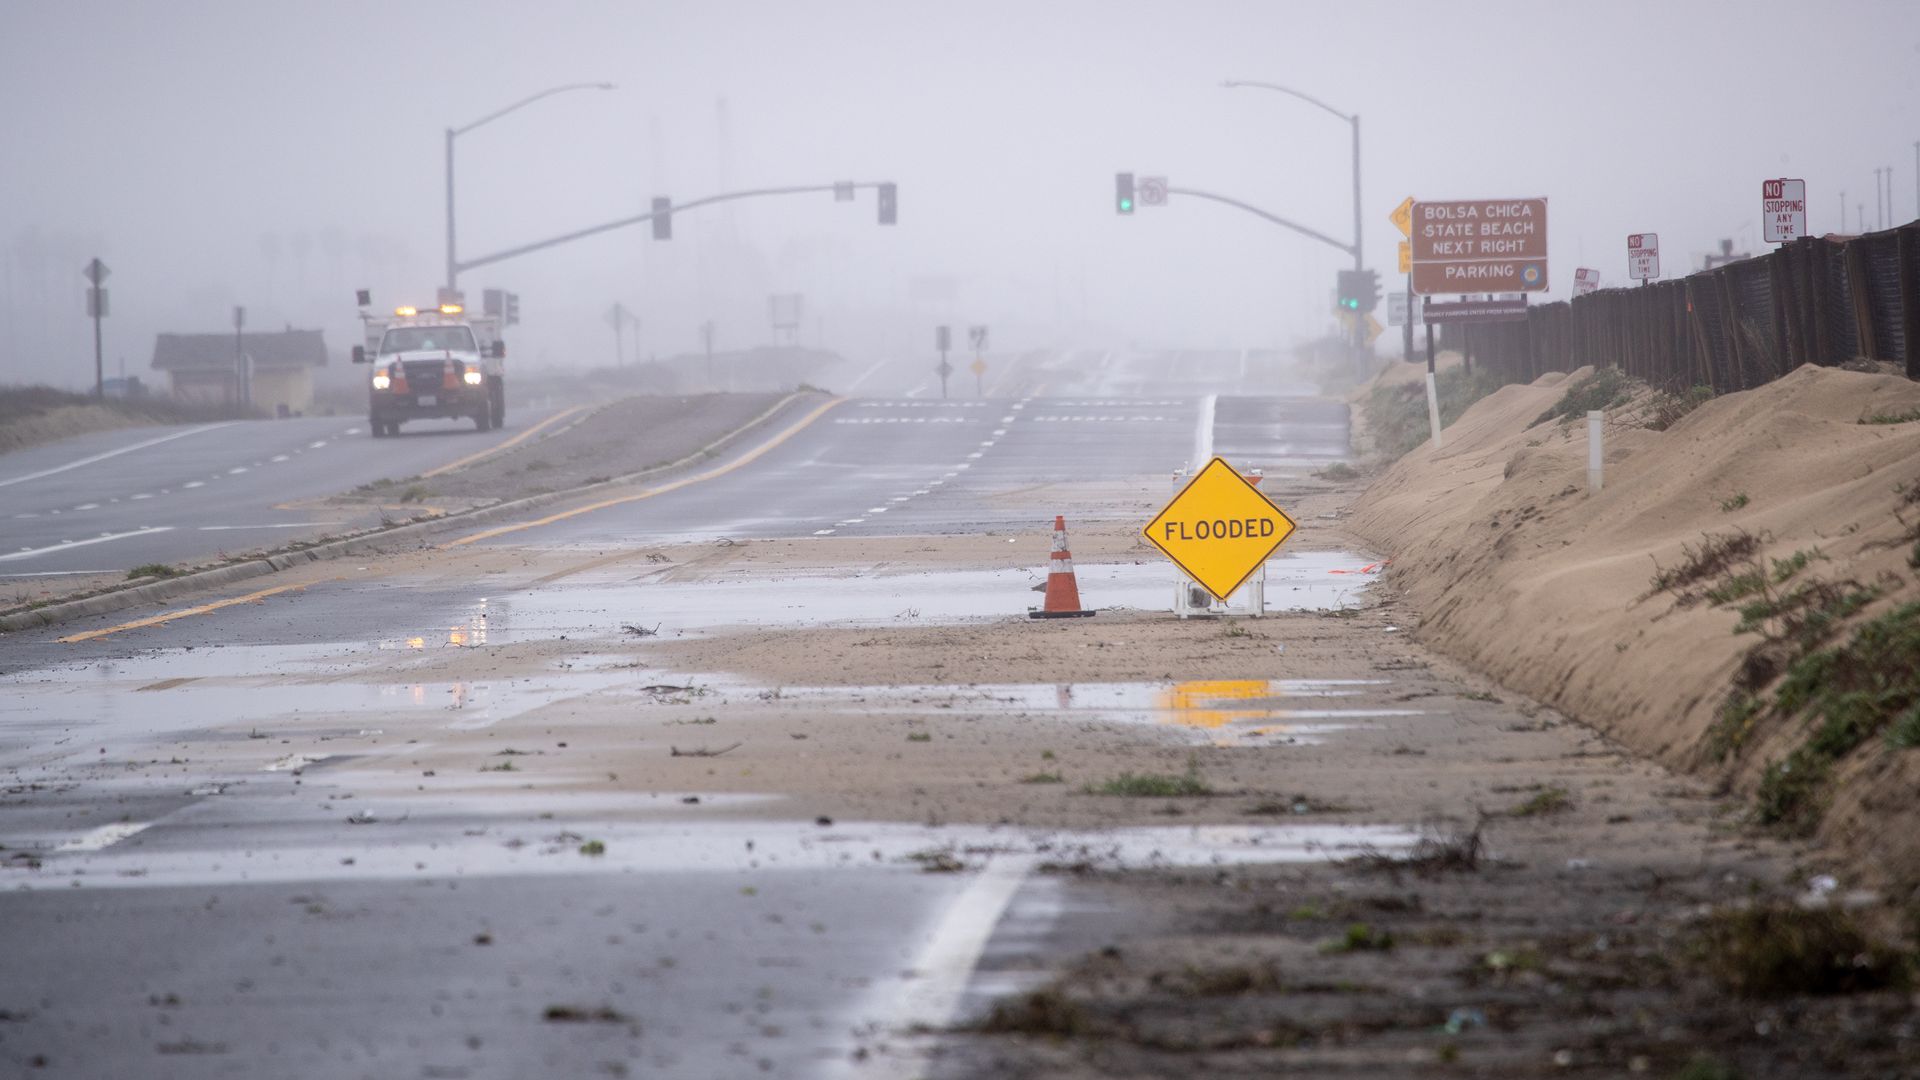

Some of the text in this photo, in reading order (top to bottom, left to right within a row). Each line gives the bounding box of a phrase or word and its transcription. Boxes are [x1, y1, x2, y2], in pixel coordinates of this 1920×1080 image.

[1765, 182, 1780, 196] NO
[1424, 205, 1532, 219] BOLSA CHICA
[1766, 200, 1803, 213] STOPPING
[1776, 214, 1792, 223] ANY
[1424, 222, 1534, 237] STATE BEACH
[1776, 225, 1794, 234] TIME
[1433, 240, 1525, 255] NEXT RIGHT
[1629, 236, 1640, 247] NO
[1630, 248, 1656, 259] STOPPING
[1445, 265, 1514, 279] PARKING
[1165, 518, 1274, 541] FLOODED
